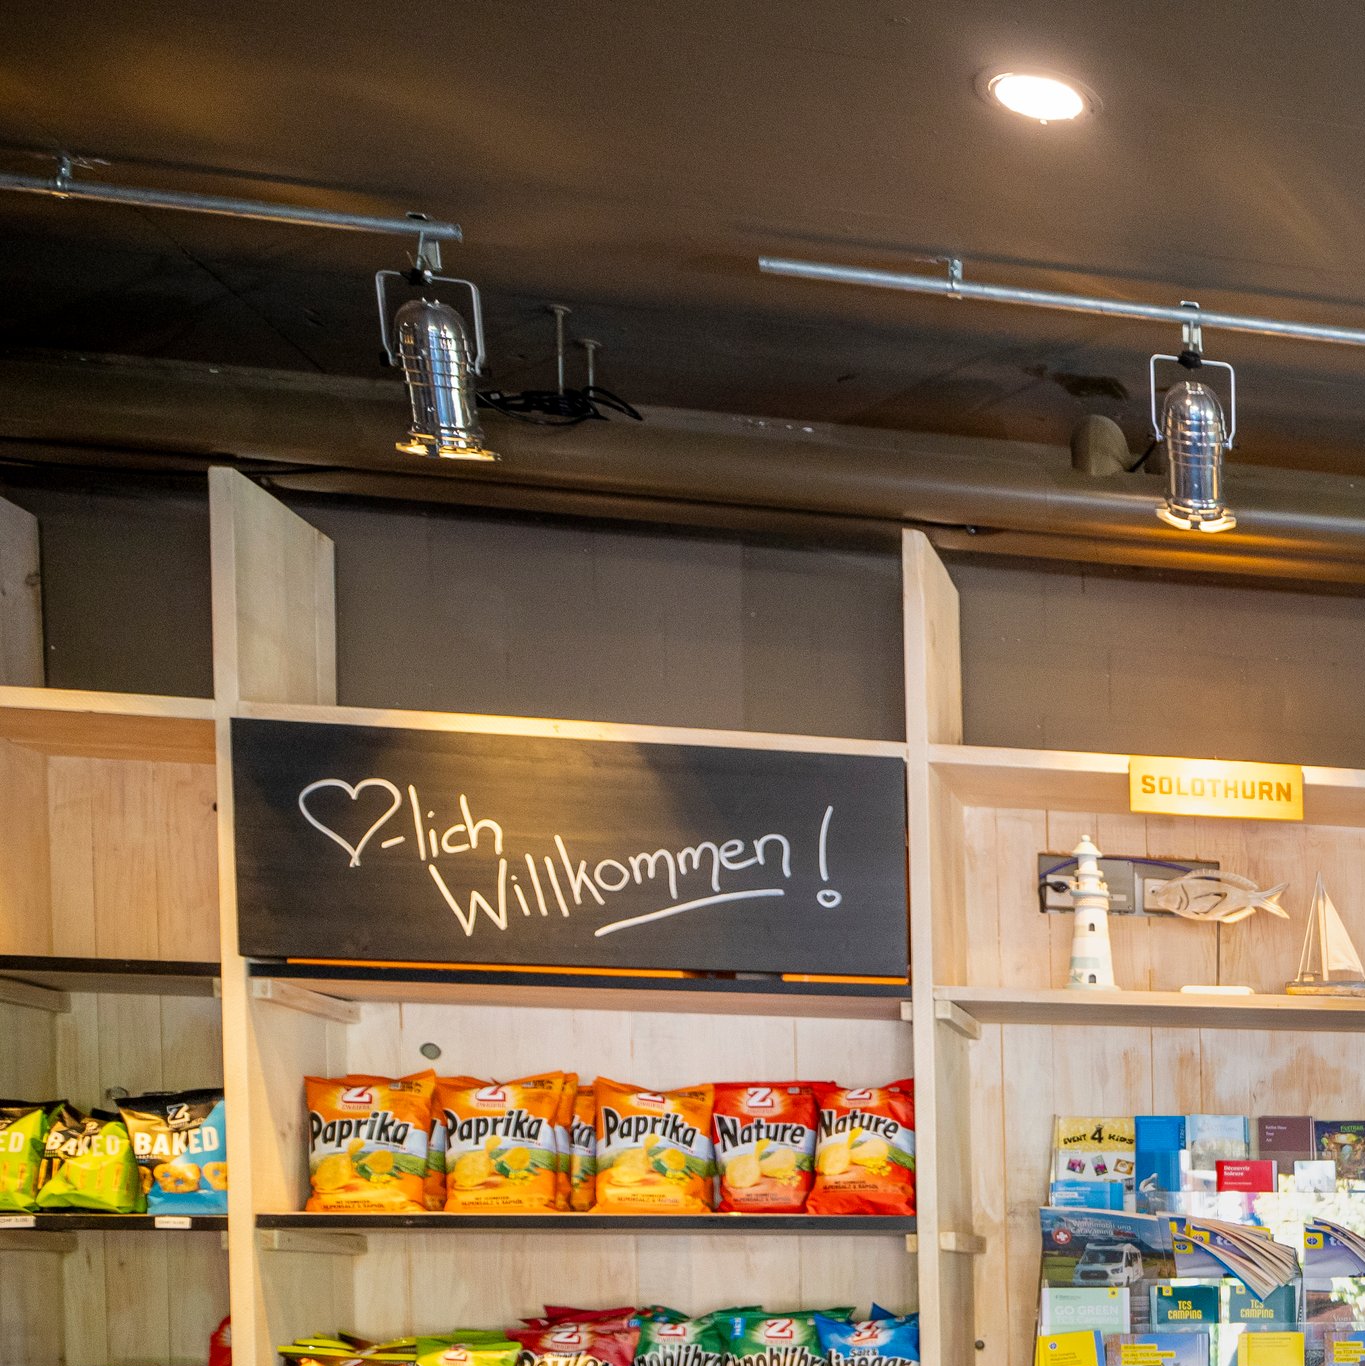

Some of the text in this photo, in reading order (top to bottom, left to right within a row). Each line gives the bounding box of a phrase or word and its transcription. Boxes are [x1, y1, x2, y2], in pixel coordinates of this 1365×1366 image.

[1141, 775, 1292, 802] SOLOTHURN
[428, 833, 792, 936] Willkommen
[310, 1111, 410, 1151] Paprika
[444, 1109, 543, 1150] Paprika
[603, 1106, 699, 1148] Paprika
[714, 1113, 805, 1149] Nature
[818, 1108, 900, 1143] Nature
[1063, 1133, 1087, 1145] EVENT
[1091, 1126, 1104, 1143] 4
[45, 1131, 121, 1157] BAKED
[134, 1126, 220, 1157] BAKED
[1054, 1304, 1119, 1316] GO GREEN
[1167, 1310, 1202, 1320] CAMPING
[1177, 1300, 1192, 1310] TCS
[1240, 1309, 1274, 1319] CAMPING
